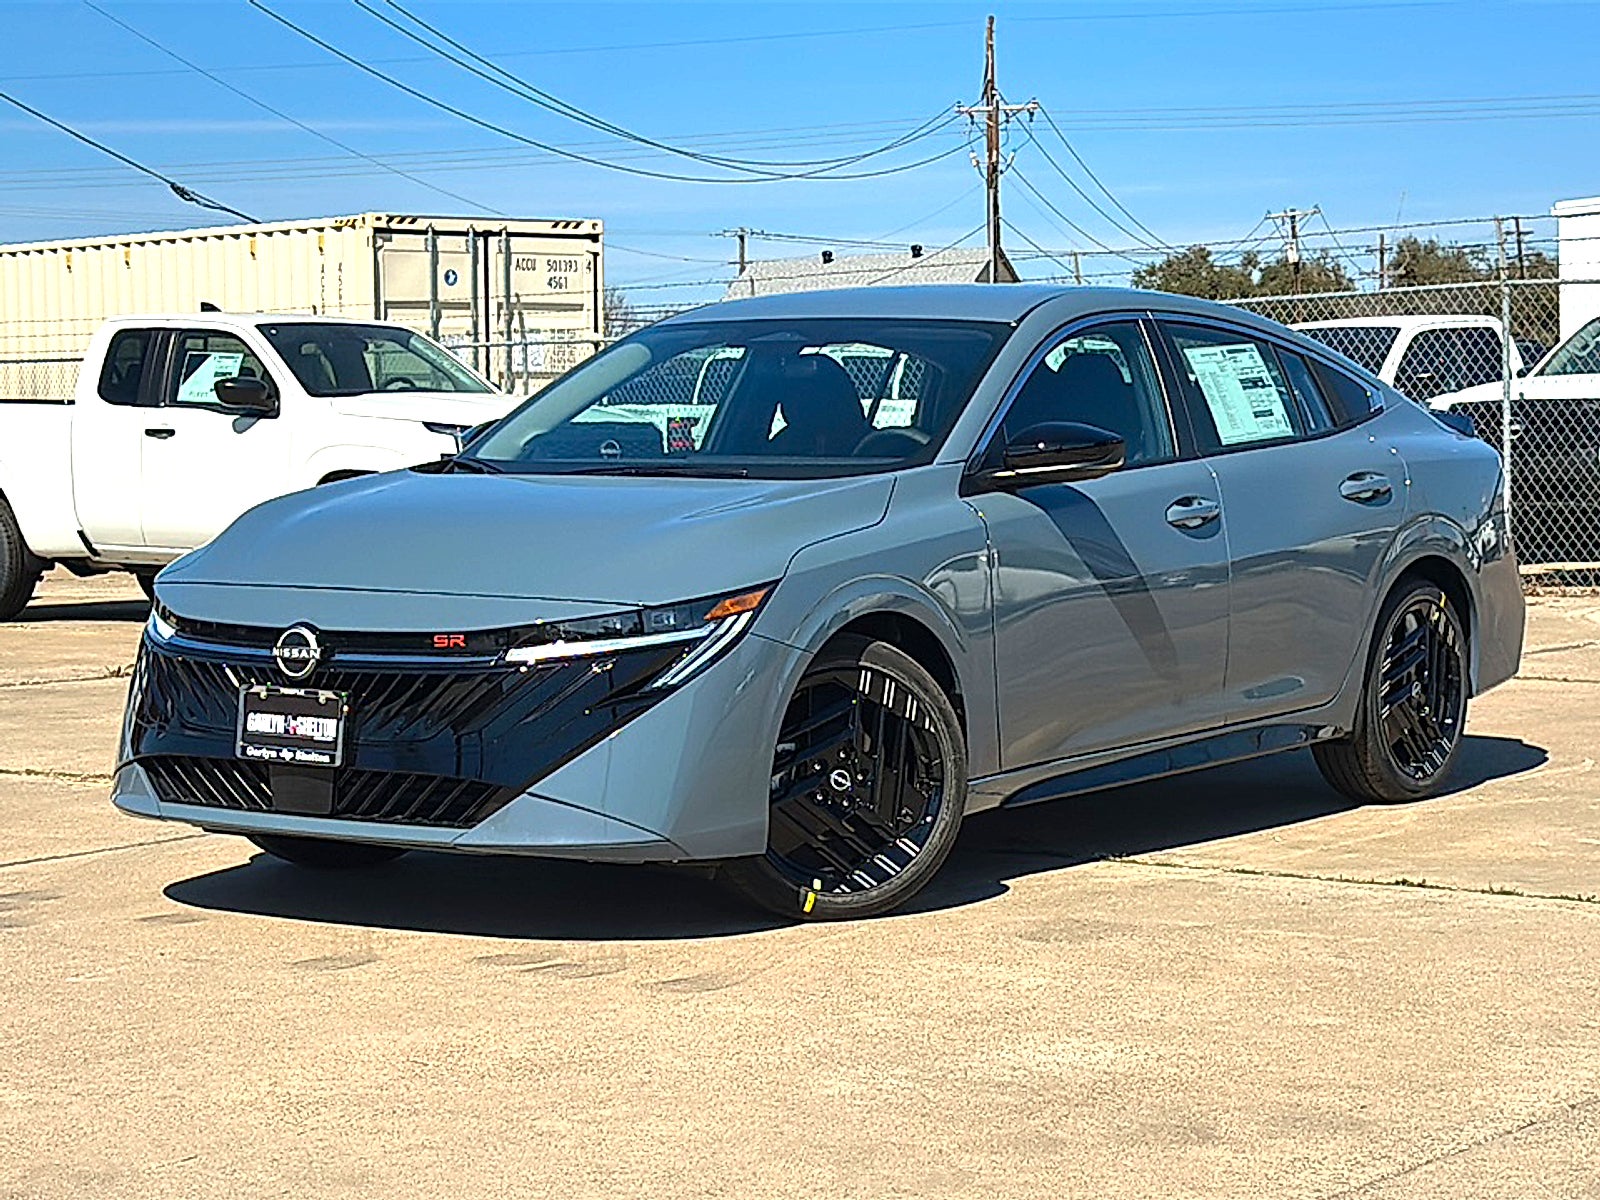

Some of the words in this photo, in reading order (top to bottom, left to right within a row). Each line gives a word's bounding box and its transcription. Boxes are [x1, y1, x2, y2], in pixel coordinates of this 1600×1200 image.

[515, 257, 537, 271] ACCU
[547, 258, 578, 273] 501393
[433, 634, 466, 649] SR
[272, 646, 322, 660] NISSAN
